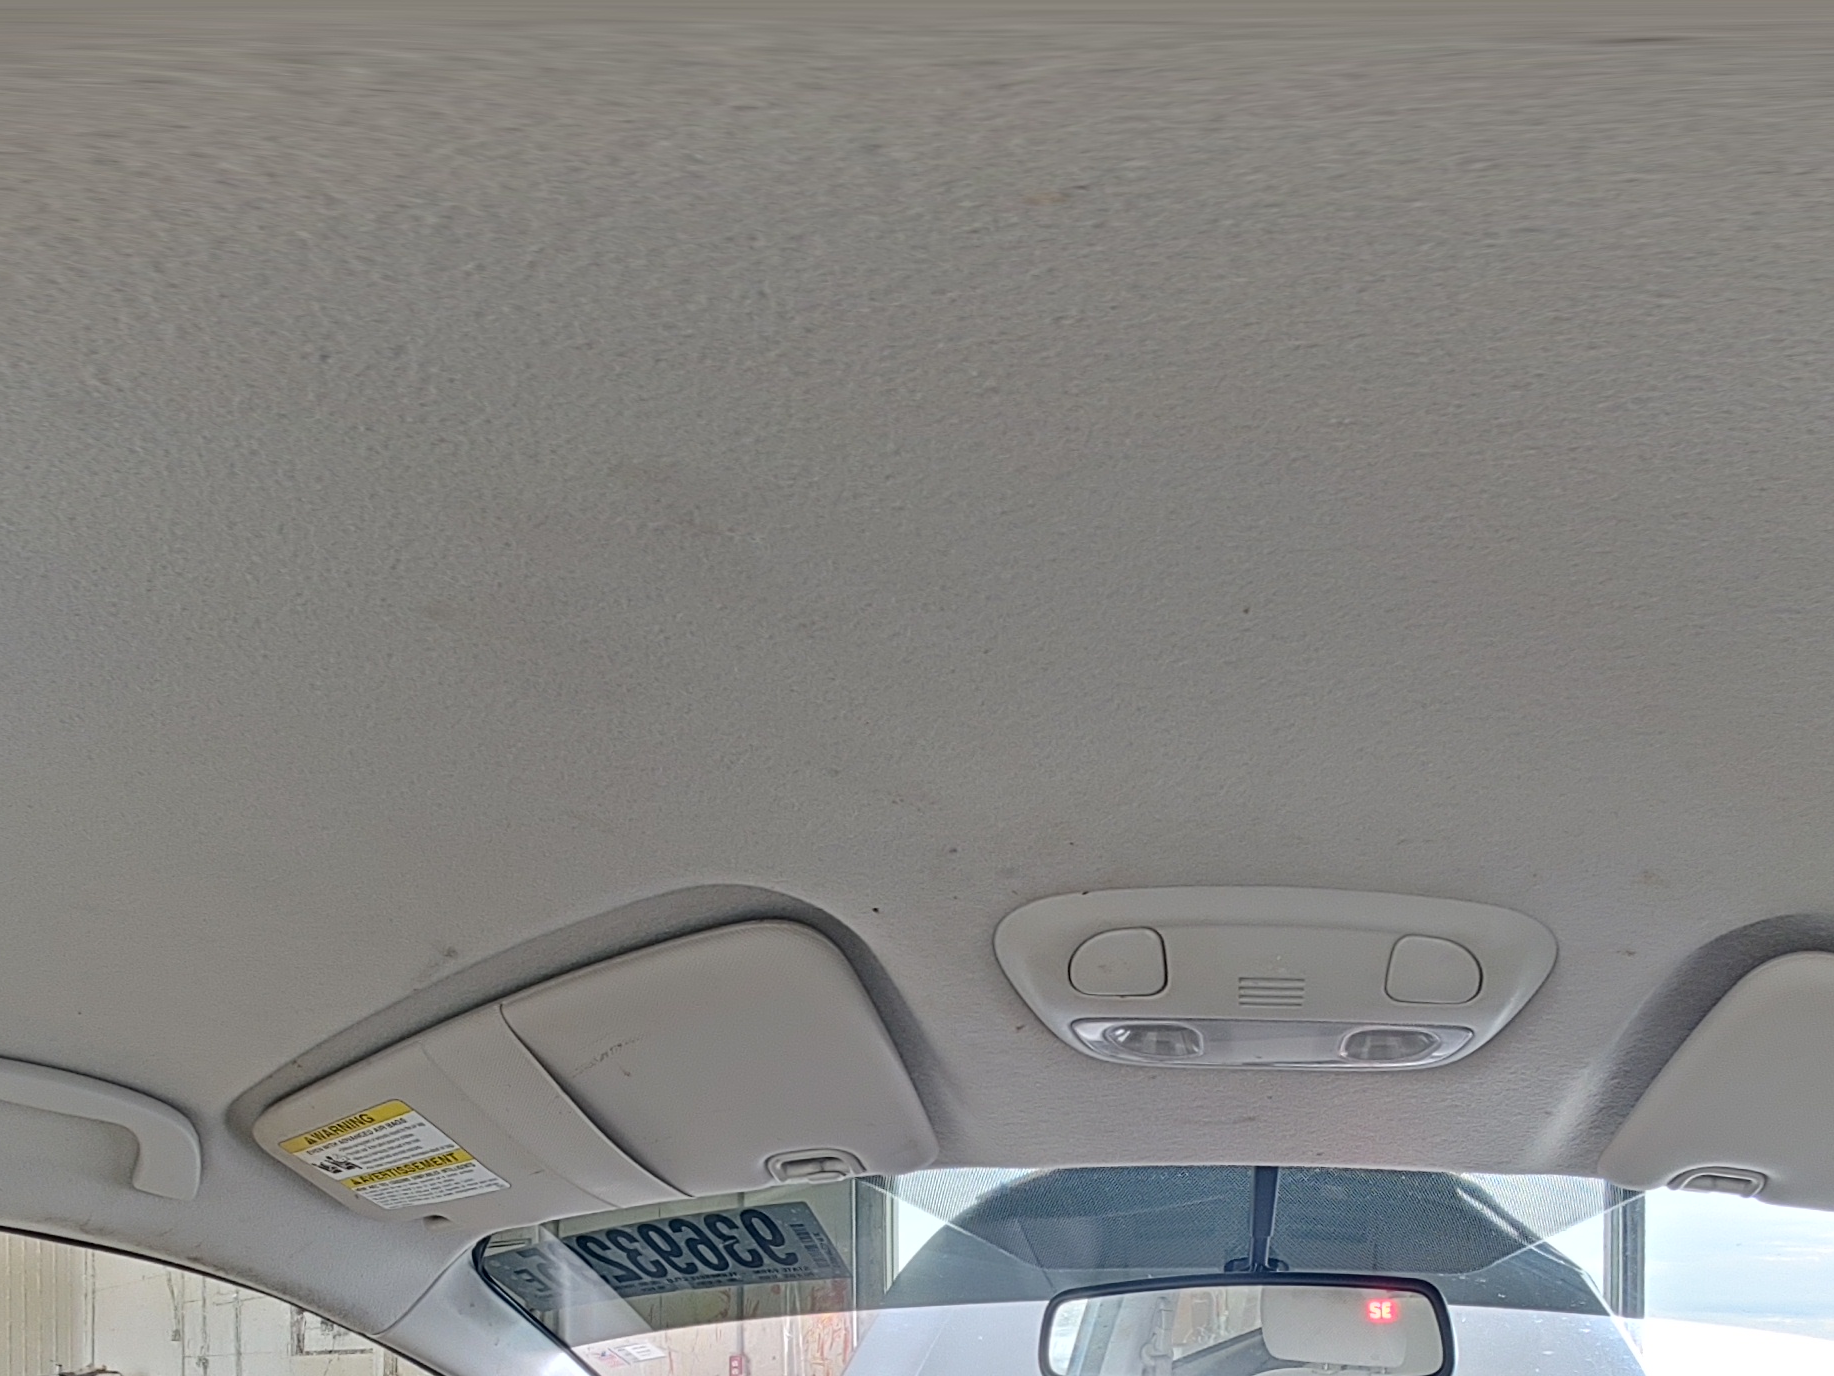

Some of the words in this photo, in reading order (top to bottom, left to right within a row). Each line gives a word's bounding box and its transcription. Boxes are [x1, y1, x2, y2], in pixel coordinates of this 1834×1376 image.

[311, 1113, 376, 1142] WARNING
[359, 1152, 460, 1185] AVERTISSEMENT
[1369, 1301, 1392, 1319] SE
